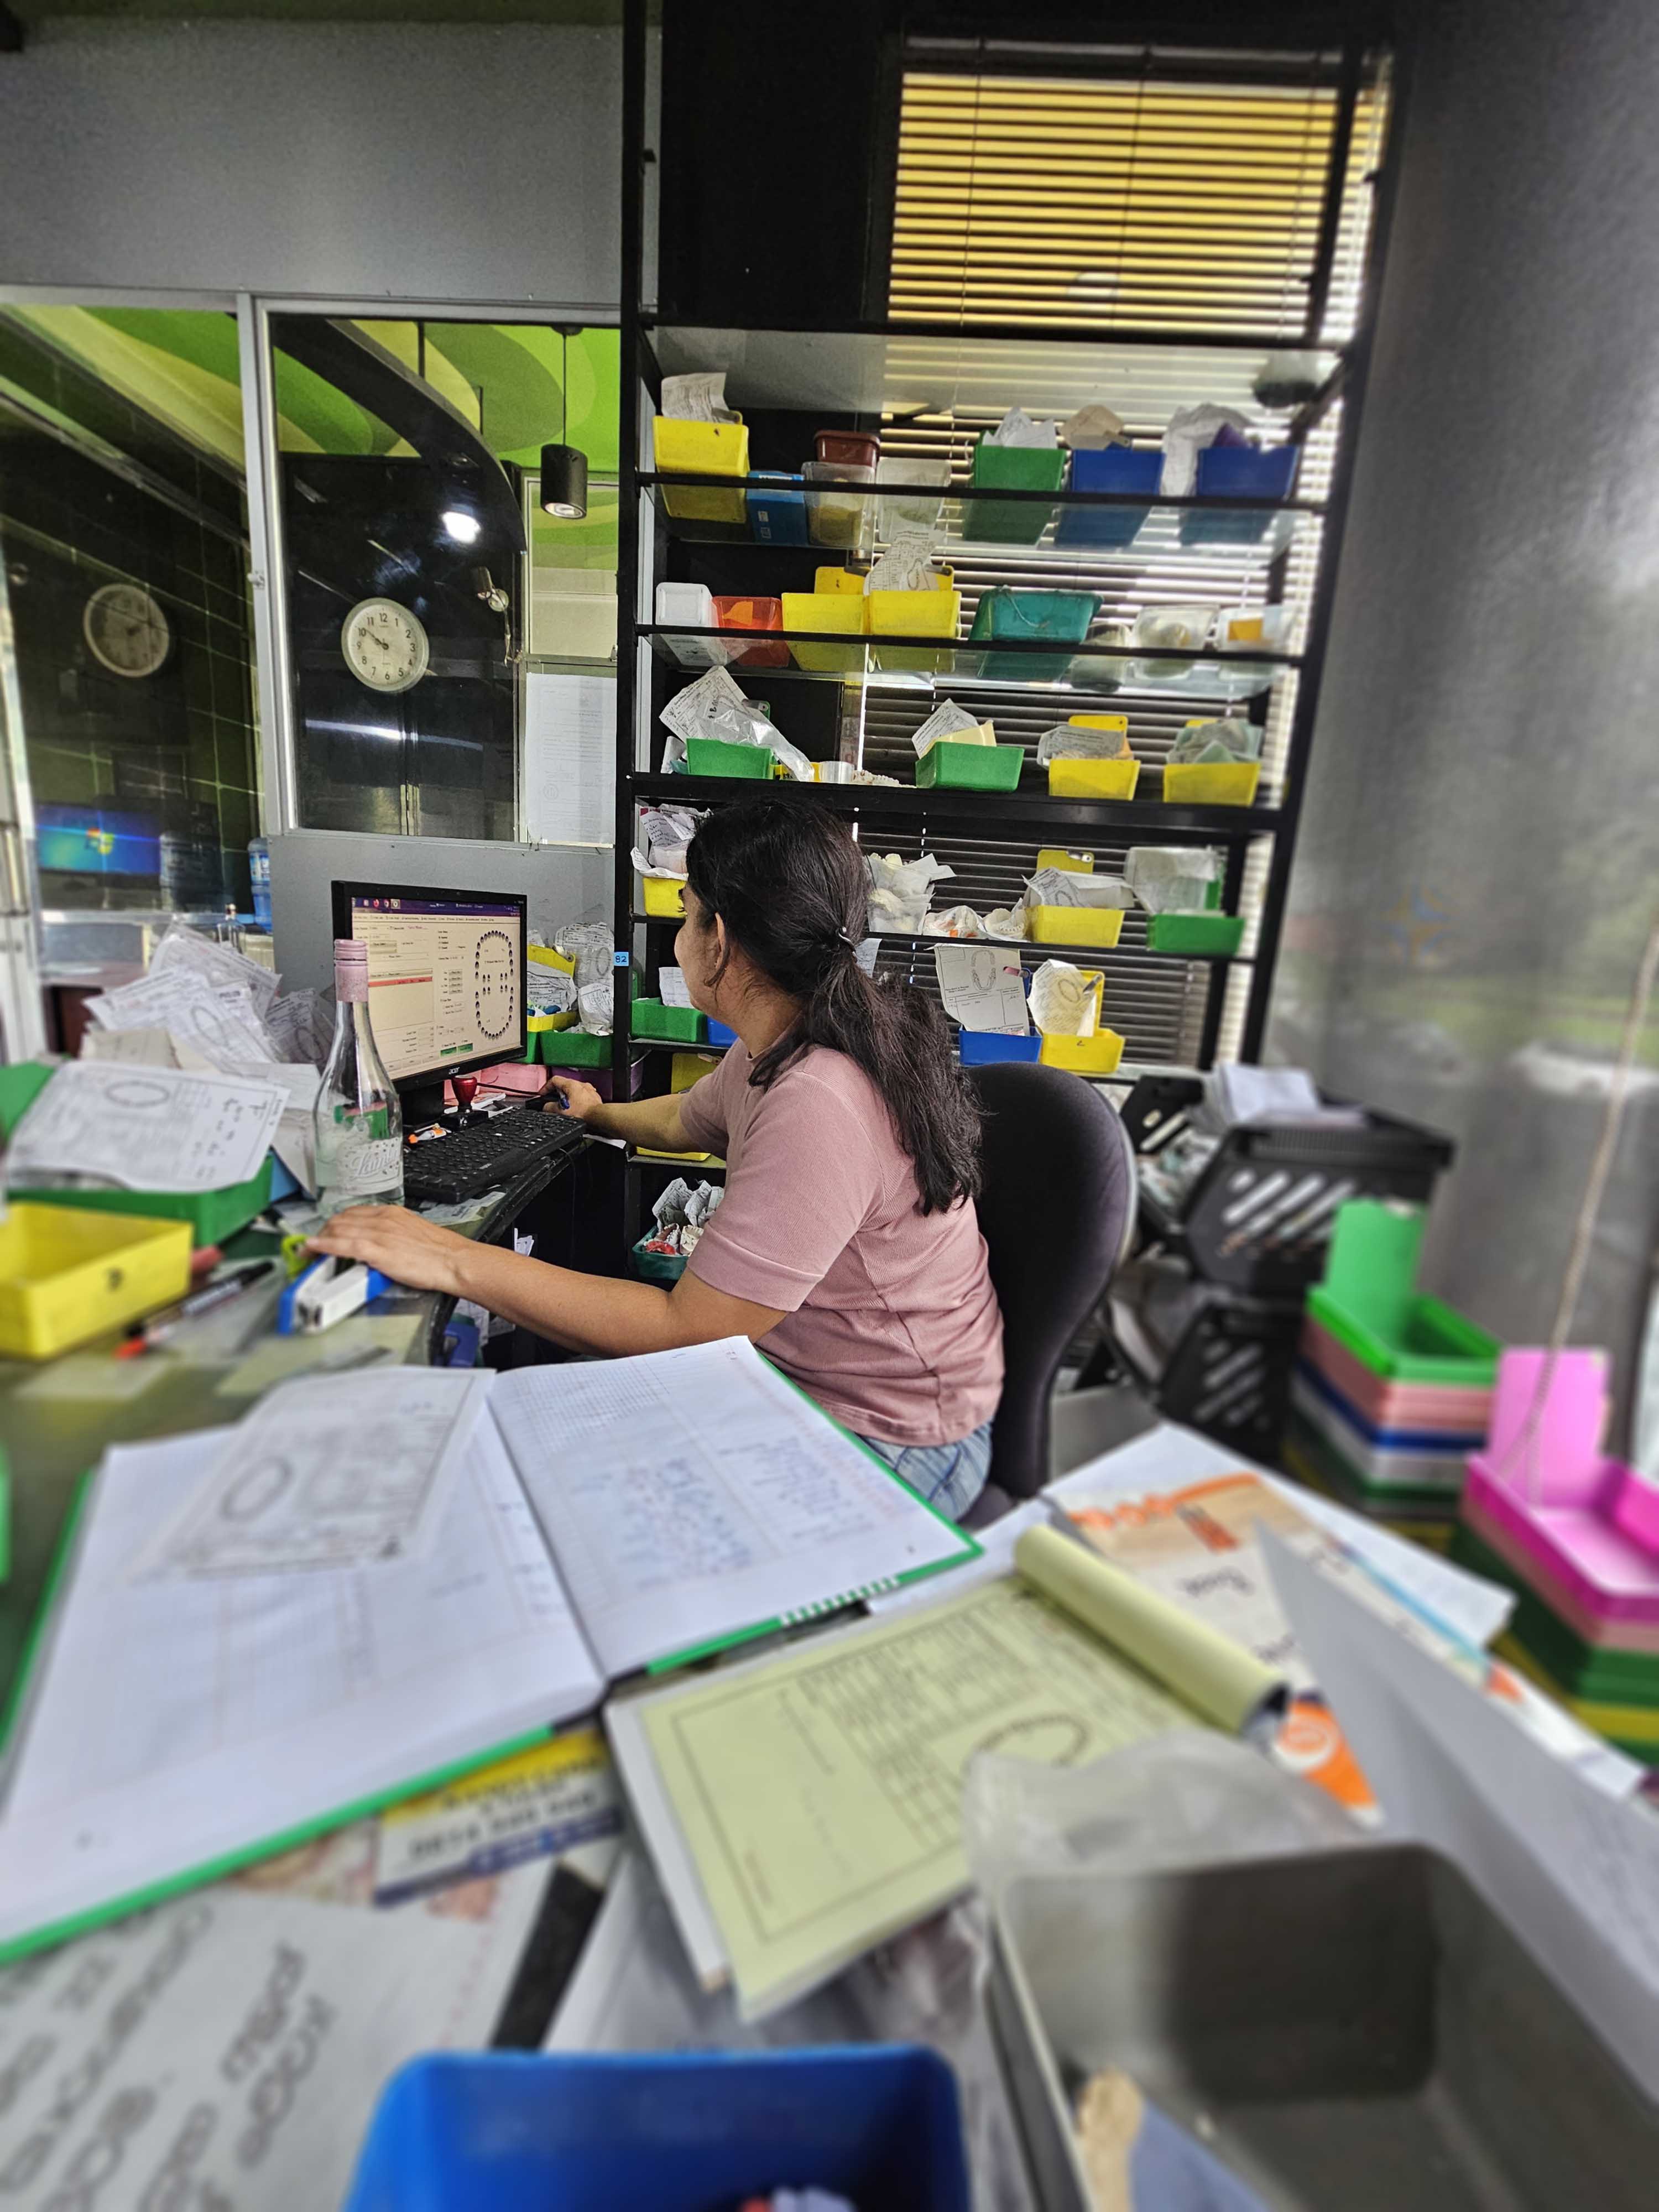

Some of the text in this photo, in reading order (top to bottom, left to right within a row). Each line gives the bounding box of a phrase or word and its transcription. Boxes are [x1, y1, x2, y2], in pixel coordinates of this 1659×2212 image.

[367, 617, 374, 626] 11
[379, 613, 388, 623] 12
[395, 618, 399, 627] 1
[358, 627, 367, 637] 10
[405, 629, 411, 638] 2
[357, 641, 362, 650] 9
[410, 643, 416, 652] 3
[362, 656, 367, 665] 8
[372, 666, 376, 676] 7
[385, 671, 390, 680] 6
[398, 667, 404, 677] 5
[448, 1067, 460, 1075] acer
